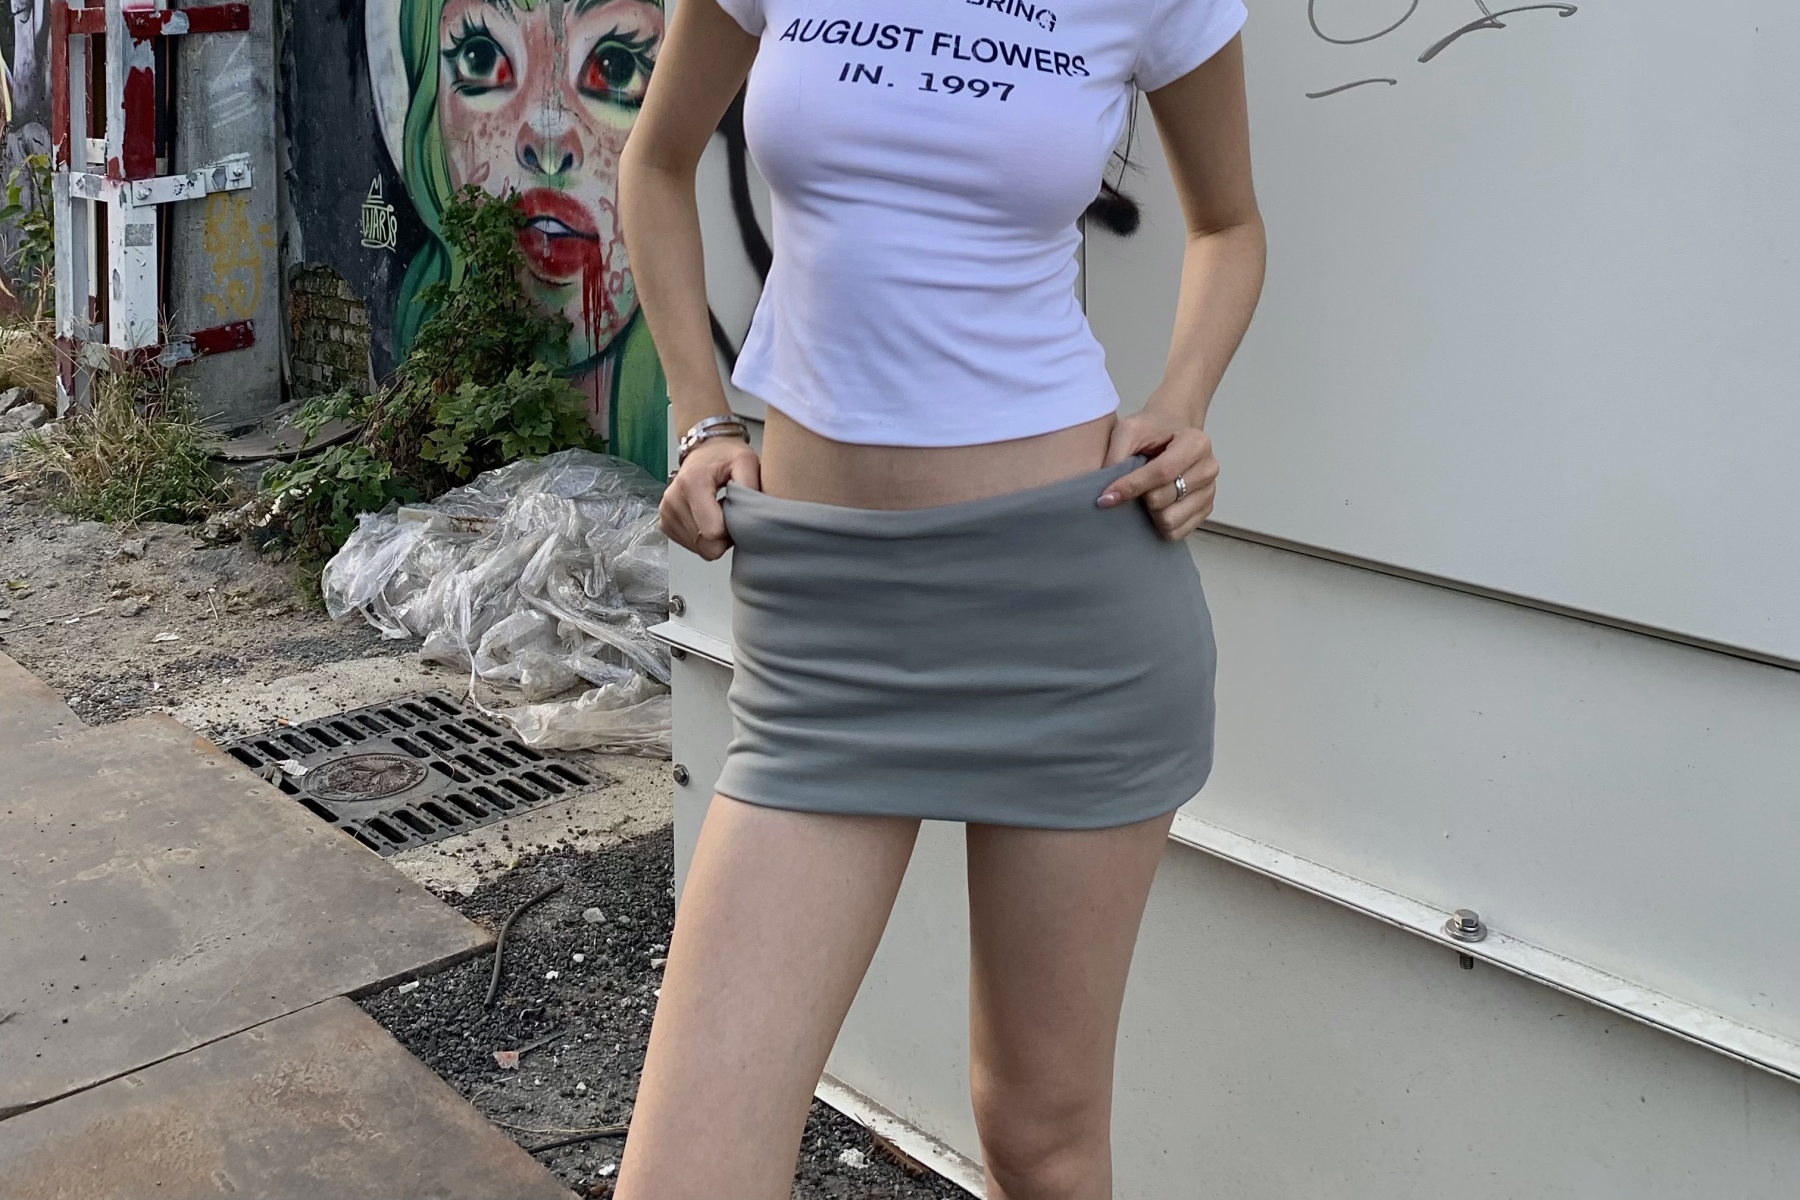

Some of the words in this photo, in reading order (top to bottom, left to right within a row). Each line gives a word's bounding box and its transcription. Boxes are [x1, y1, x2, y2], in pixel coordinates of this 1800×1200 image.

[779, 17, 924, 52] AUGUST
[931, 31, 1090, 77] FLOWERS
[838, 62, 894, 88] IN.
[918, 71, 1015, 102] 1997
